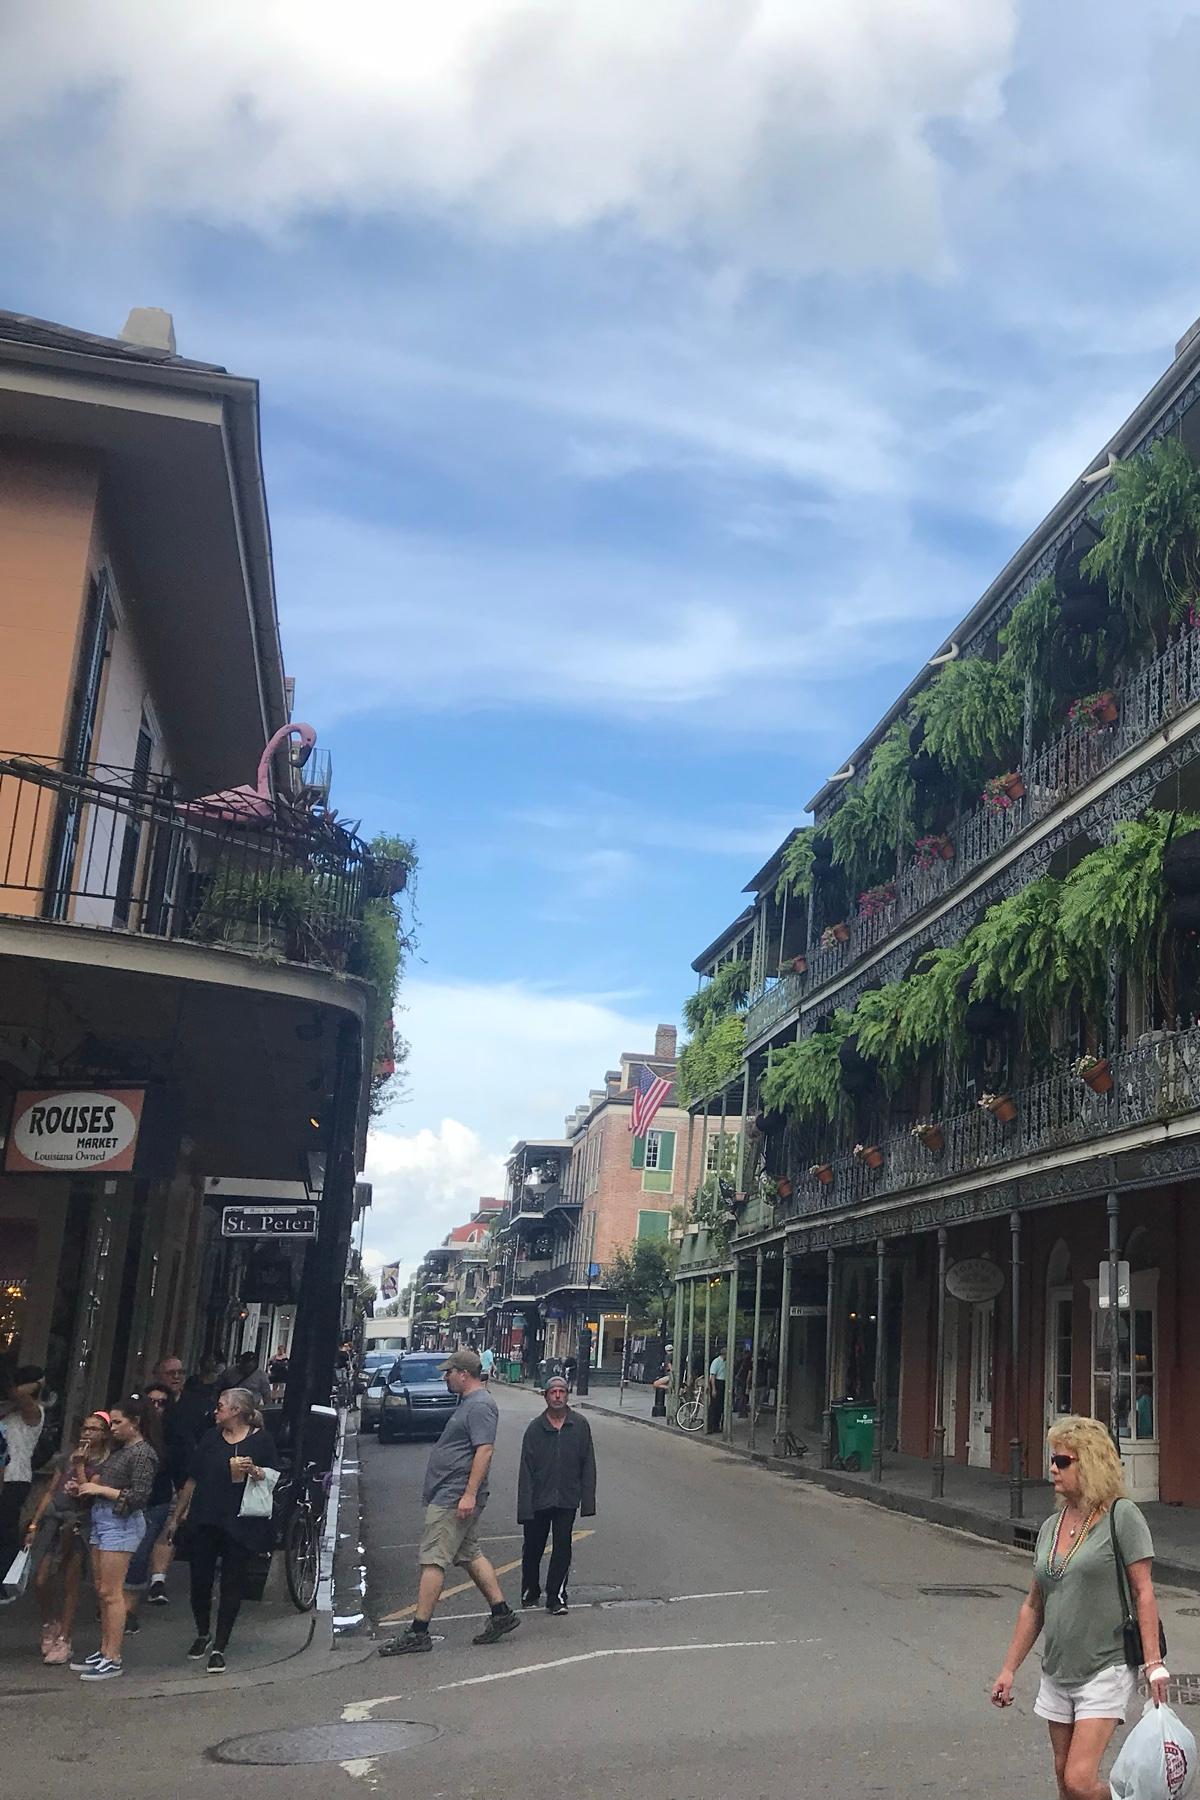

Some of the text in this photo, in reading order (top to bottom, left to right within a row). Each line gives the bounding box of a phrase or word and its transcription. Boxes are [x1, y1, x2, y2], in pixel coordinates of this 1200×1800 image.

[29, 1106, 116, 1136] ROUSES
[77, 1137, 119, 1149] MARKET
[34, 1151, 106, 1161] Louisiana Owned
[226, 1216, 312, 1231] St. Peter
